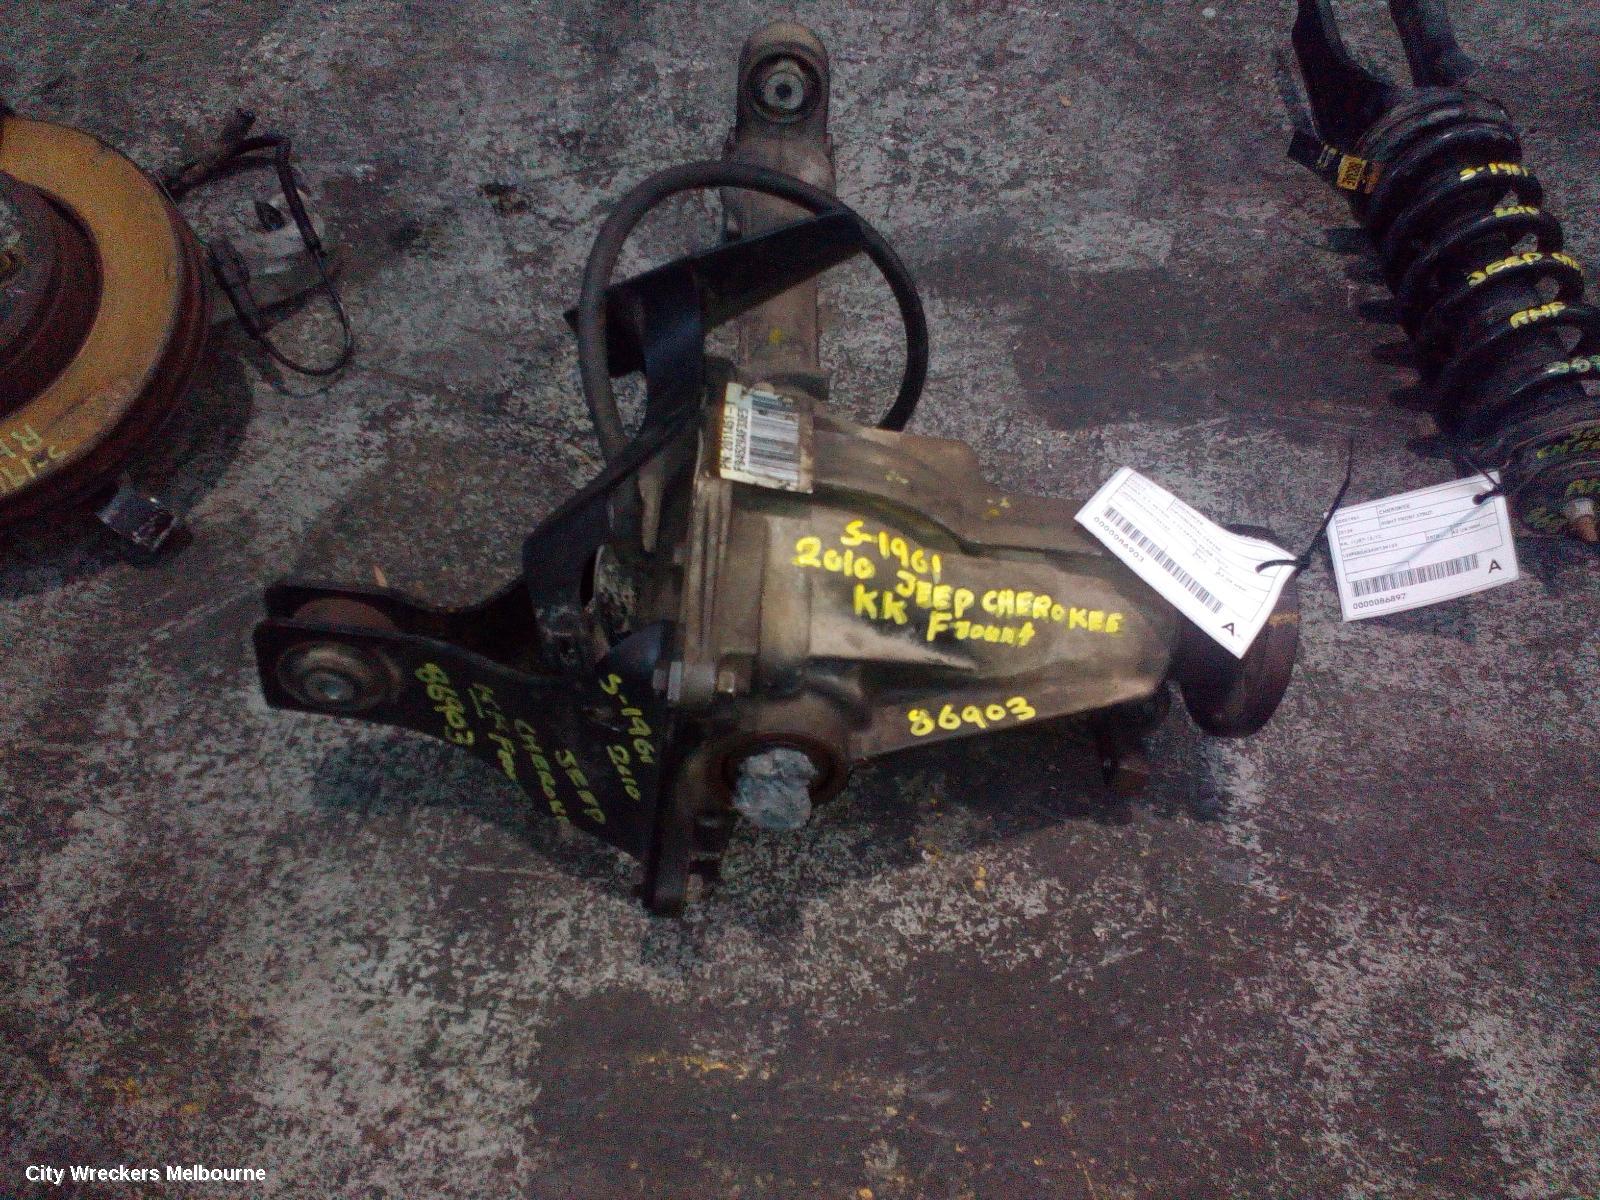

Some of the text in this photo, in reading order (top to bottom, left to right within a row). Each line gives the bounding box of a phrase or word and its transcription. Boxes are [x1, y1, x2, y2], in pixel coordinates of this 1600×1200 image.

[1488, 559, 1503, 573] A
[793, 536, 1125, 634] 2010 JEEP CHEROKEE
[1221, 622, 1235, 637] A
[908, 697, 1037, 736] 86903
